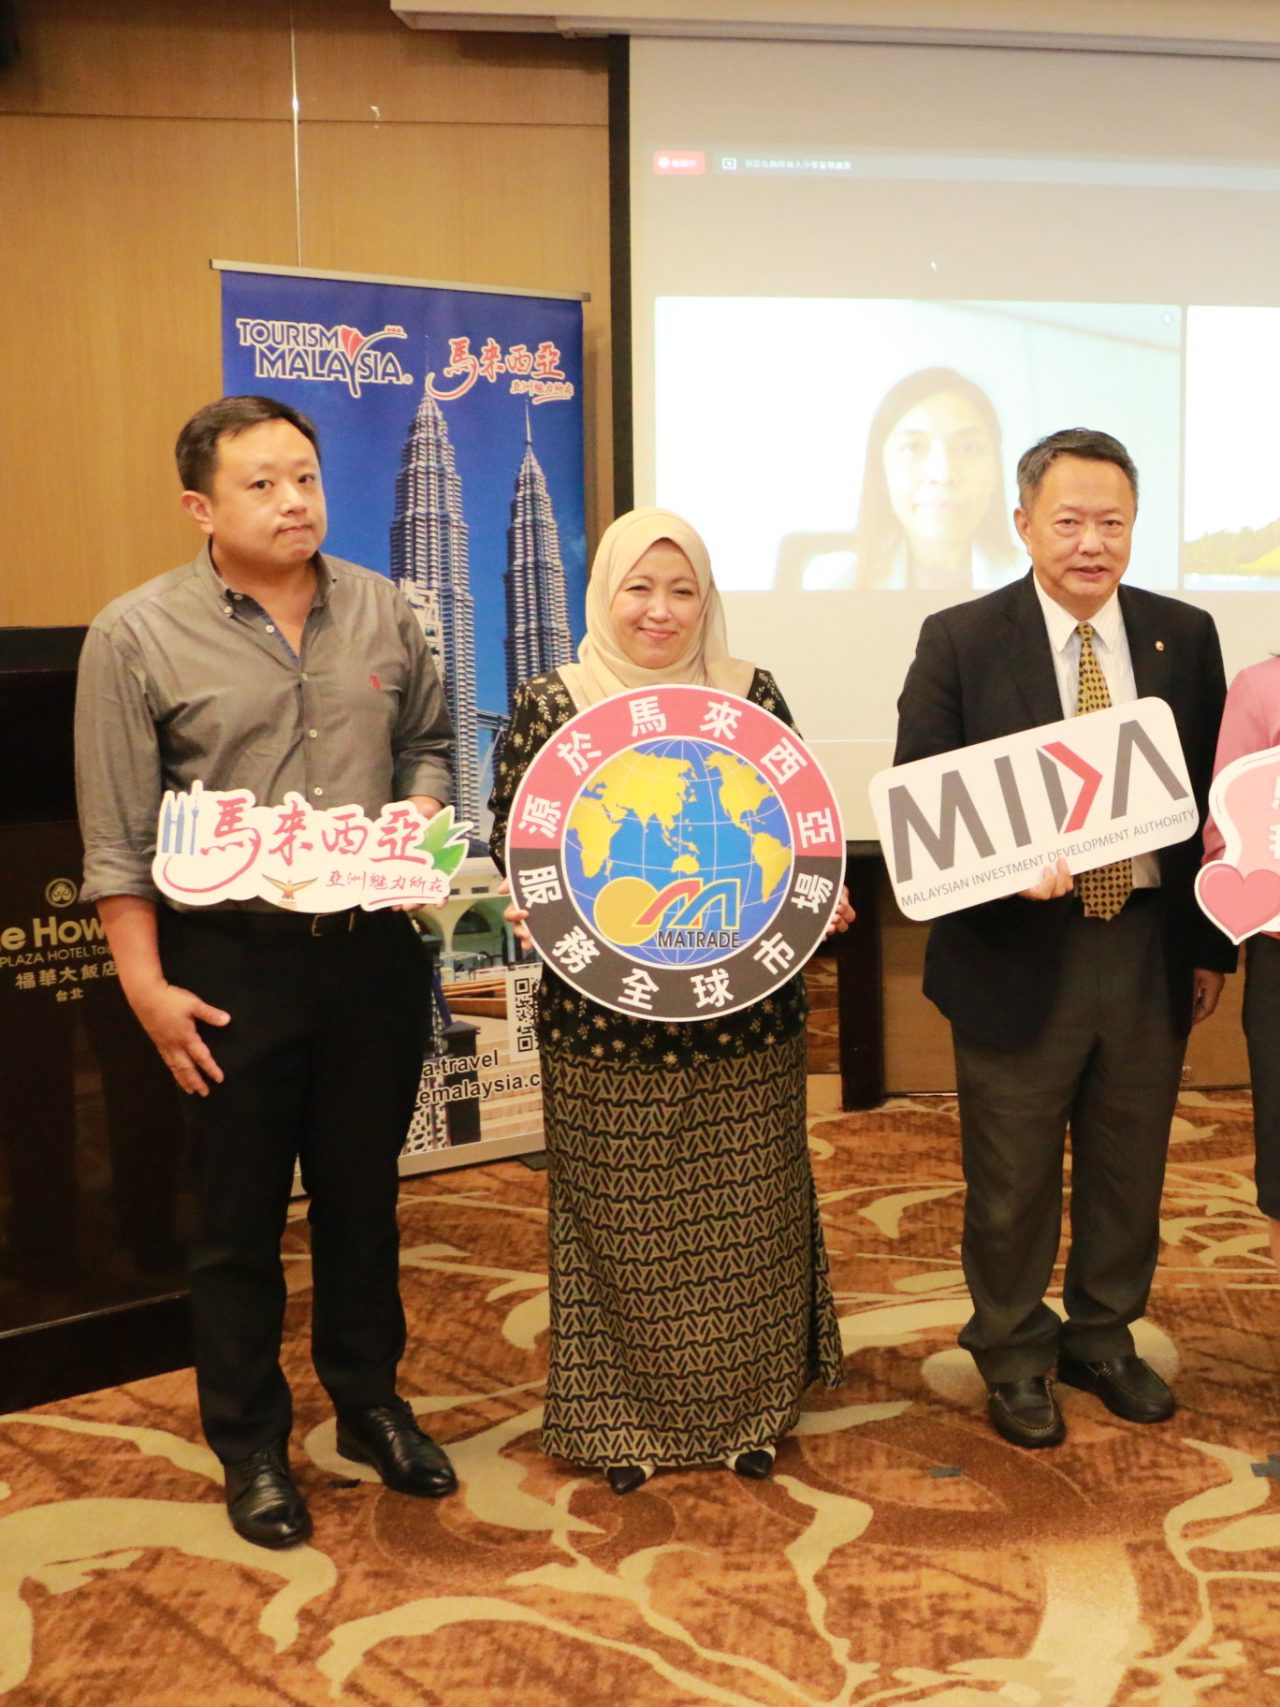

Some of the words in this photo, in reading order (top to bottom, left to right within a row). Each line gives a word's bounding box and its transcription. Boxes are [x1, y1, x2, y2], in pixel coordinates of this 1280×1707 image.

[237, 318, 340, 349] TOURISM
[255, 346, 404, 398] MALAYSIA
[888, 719, 1190, 885] MIDA
[901, 877, 970, 907] MALAYSIAN
[972, 855, 1044, 886] INVESTMENT
[1048, 832, 1130, 863] DEVELOPMENT
[1133, 809, 1196, 837] AUTHORITY
[32, 916, 104, 948] How
[656, 929, 740, 948] MATRADE
[47, 948, 90, 961] HOTEL
[422, 1049, 499, 1077] a.travel
[418, 1073, 542, 1105] emalaysia.c
